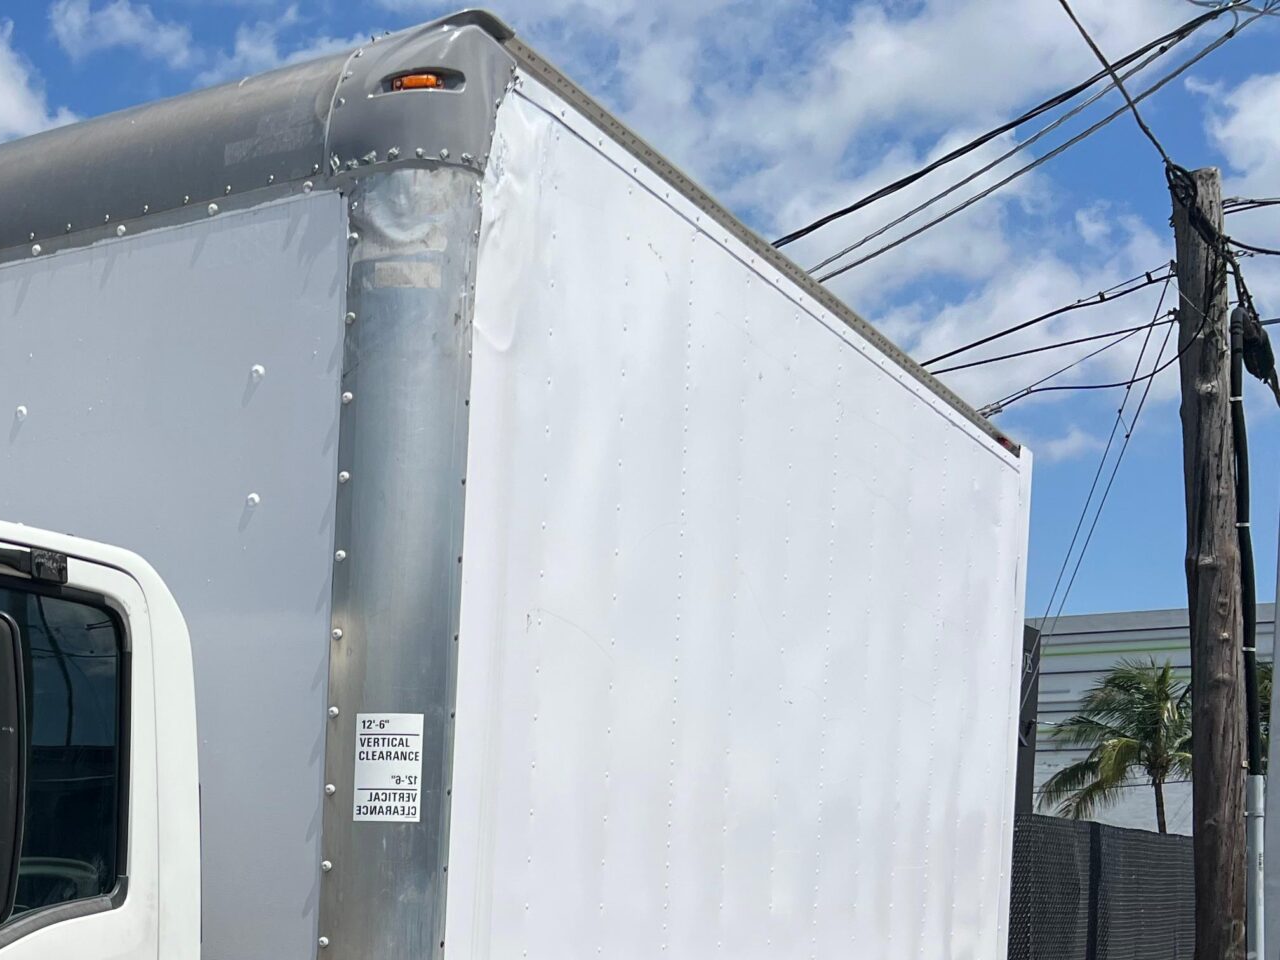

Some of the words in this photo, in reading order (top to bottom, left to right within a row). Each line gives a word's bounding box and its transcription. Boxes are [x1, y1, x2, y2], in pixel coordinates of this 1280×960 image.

[361, 719, 390, 730] 12'-6"
[359, 737, 411, 748] VERTICAL
[358, 750, 420, 762] CLEARANCE
